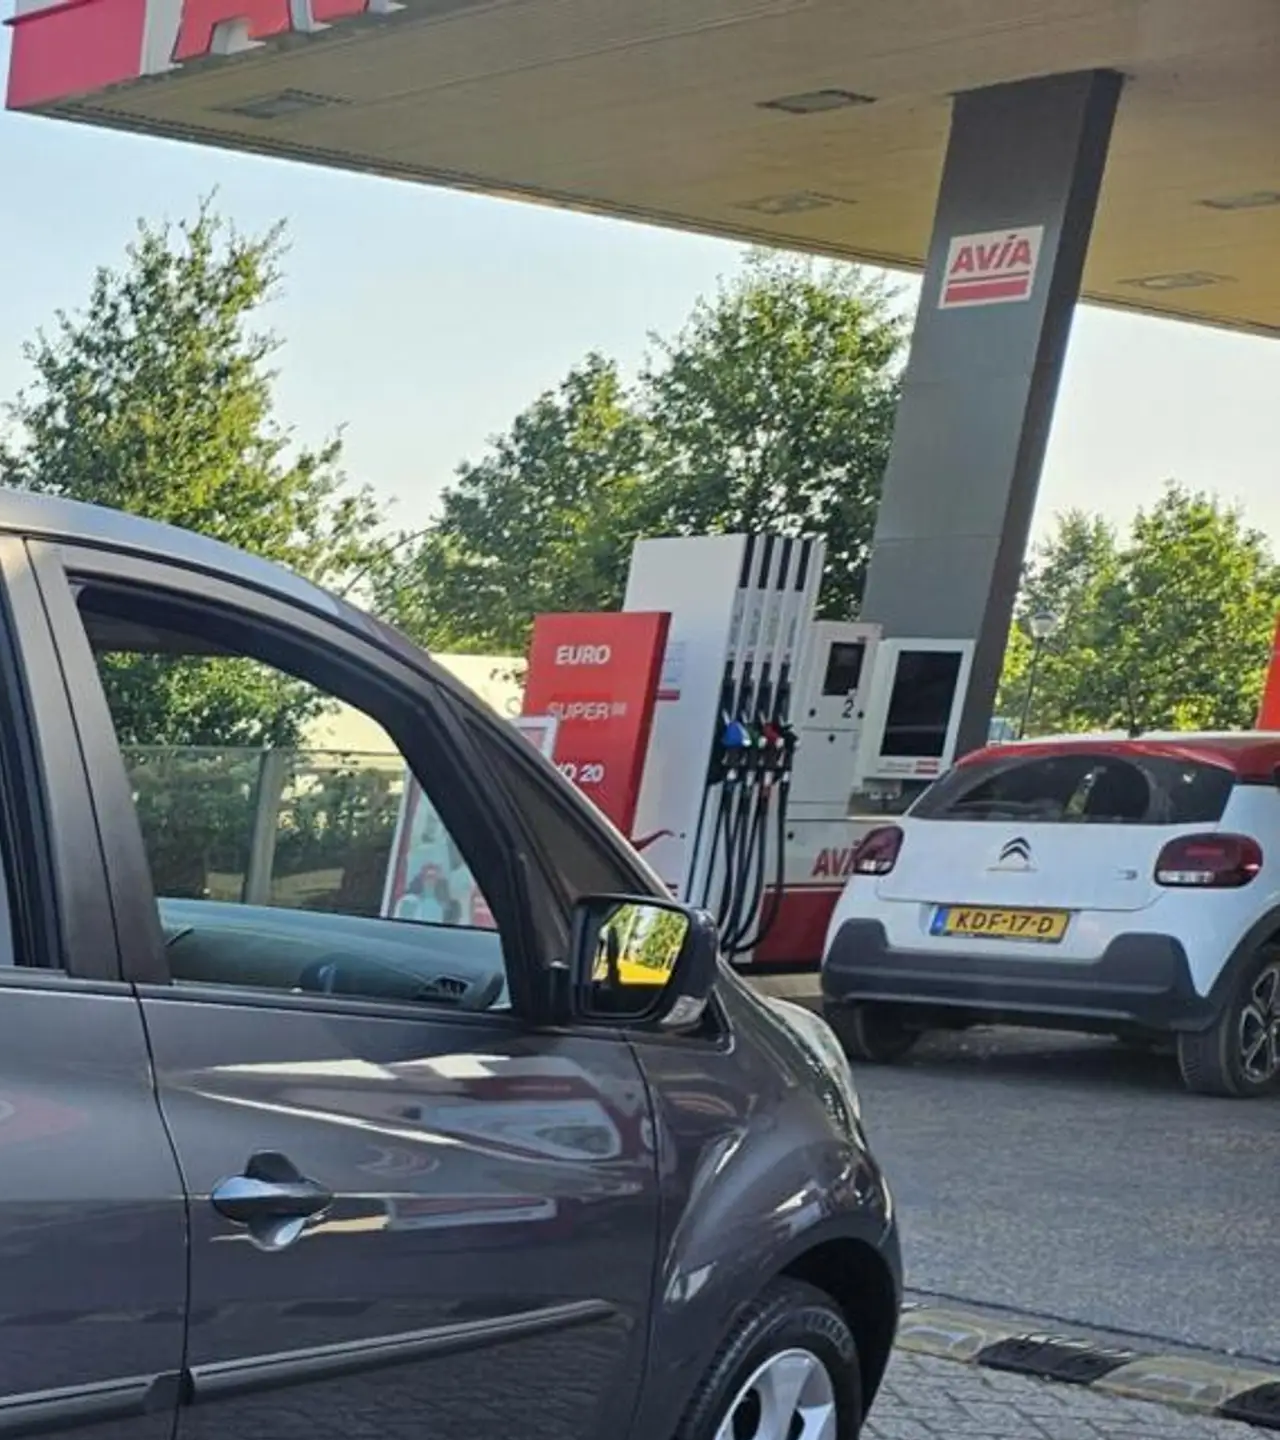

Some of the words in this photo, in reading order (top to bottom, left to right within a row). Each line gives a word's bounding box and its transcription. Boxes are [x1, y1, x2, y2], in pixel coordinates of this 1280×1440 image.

[951, 234, 1031, 275] AVIA
[555, 645, 611, 665] EURO
[548, 701, 609, 720] SUPER
[579, 763, 604, 782] 20
[812, 839, 861, 876] AVI
[955, 910, 1055, 934] KDF-17-D
